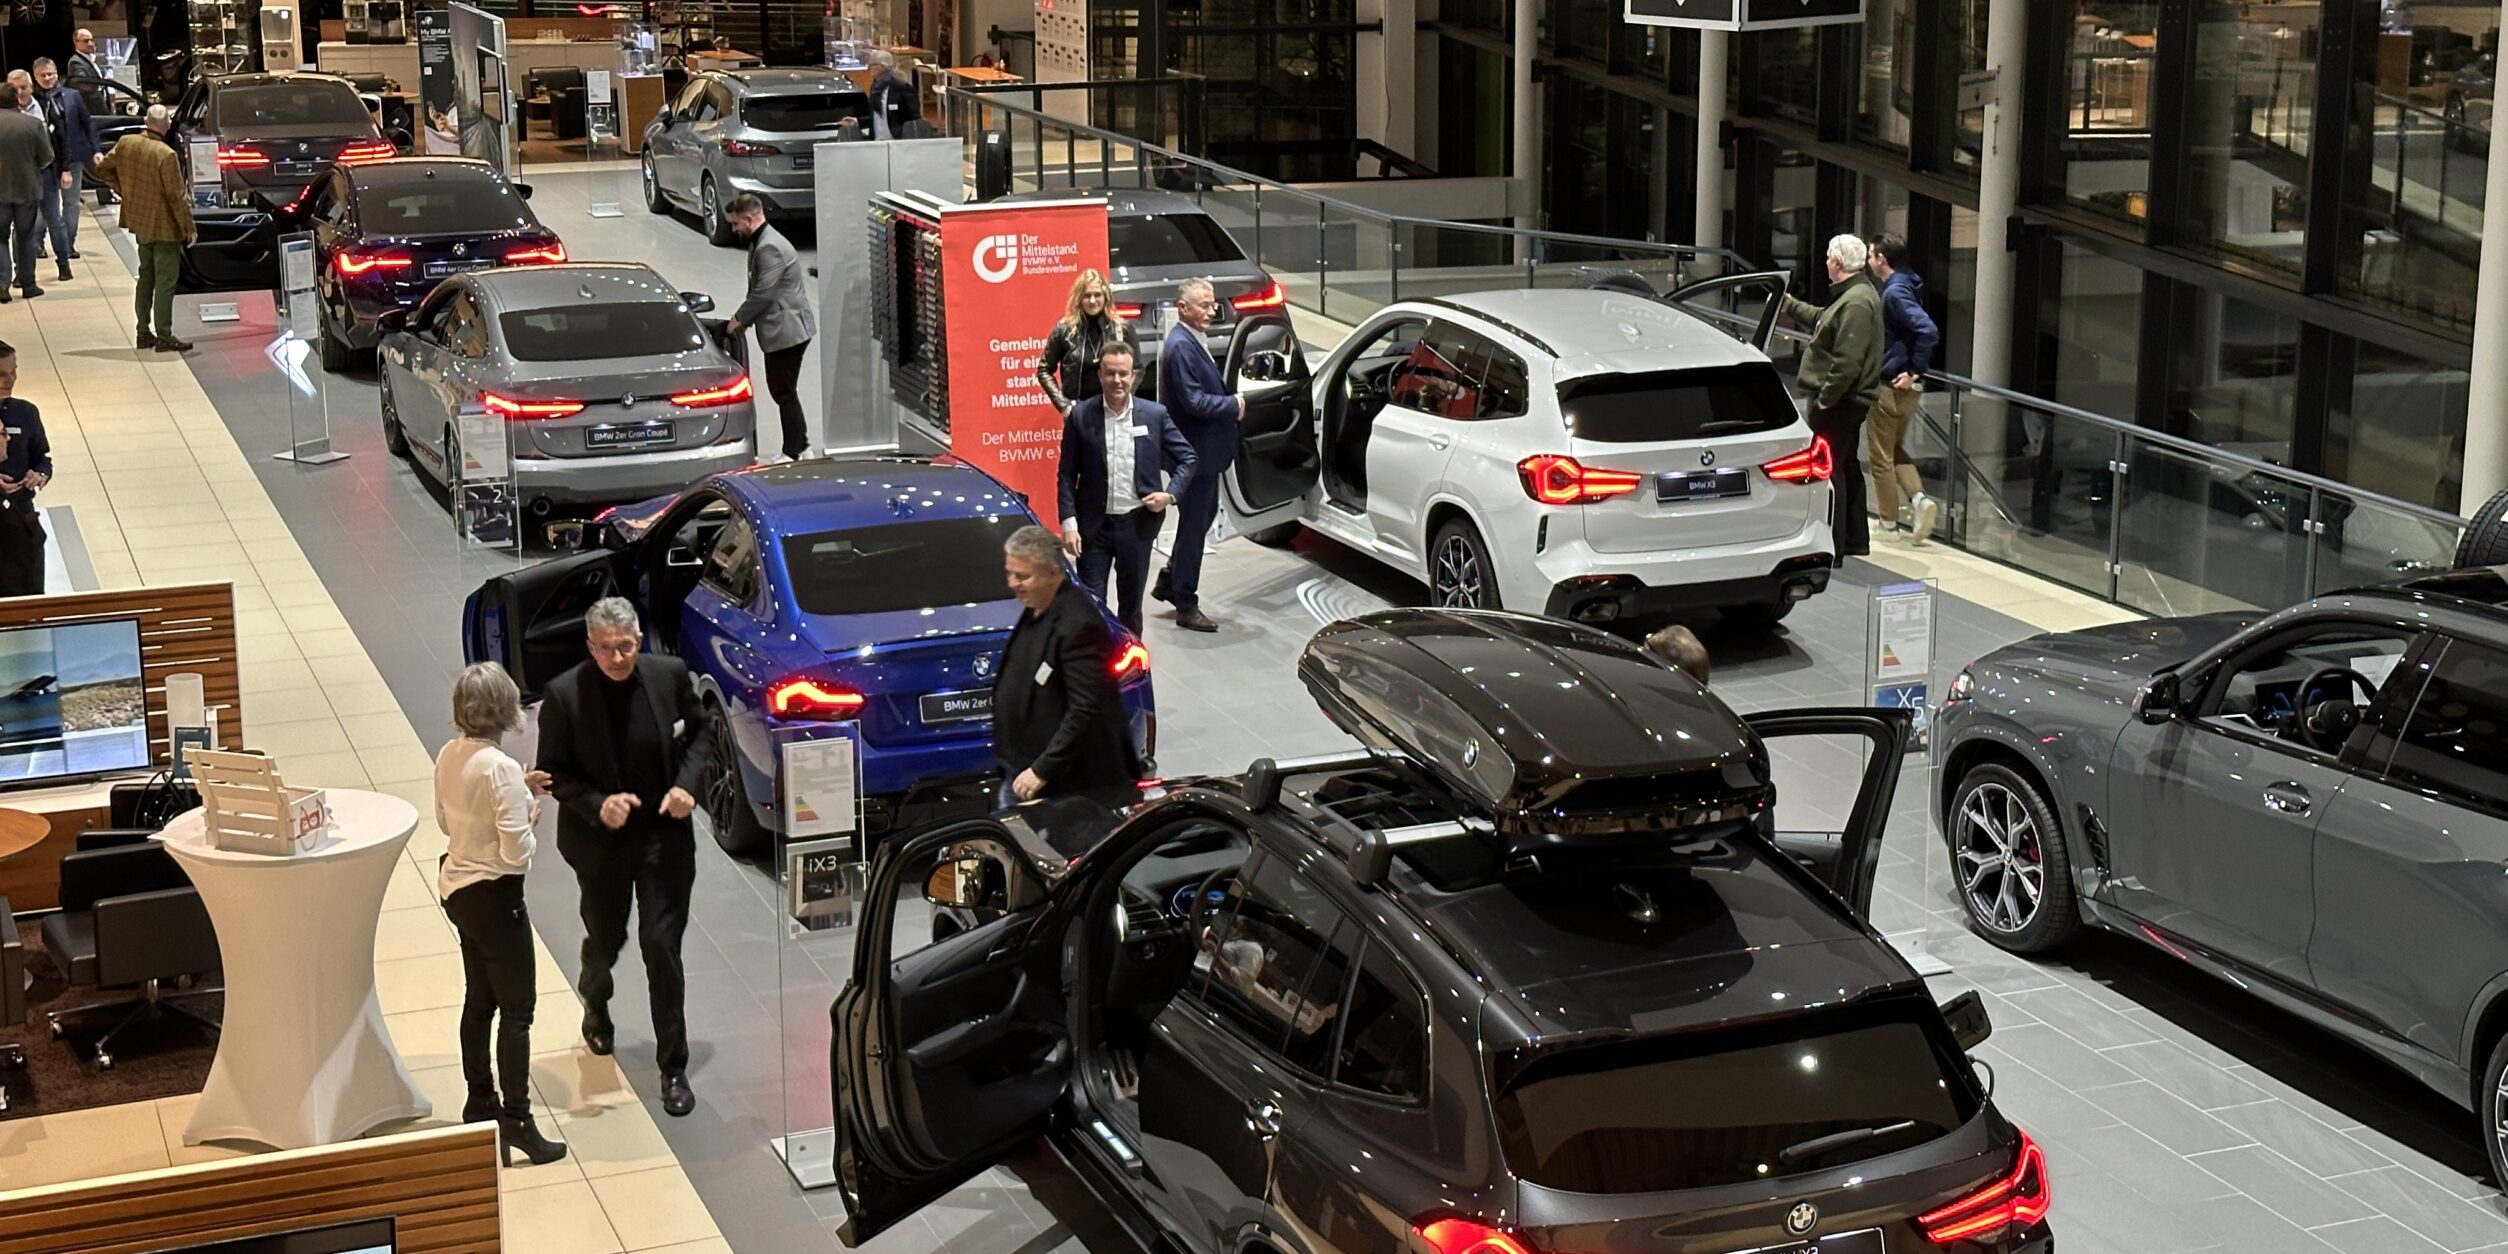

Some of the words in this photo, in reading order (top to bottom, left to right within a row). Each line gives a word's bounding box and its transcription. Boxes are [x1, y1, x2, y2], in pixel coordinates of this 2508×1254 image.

[597, 108, 602, 116] 2
[207, 190, 216, 203] 4
[1022, 233, 1038, 246] Der
[1022, 242, 1079, 257] Mittelstand.
[1022, 256, 1046, 266] BVMW
[1023, 262, 1078, 275] Bundesverband
[990, 337, 1047, 352] Gemeins
[1000, 356, 1020, 370] für
[1006, 374, 1040, 388] stark
[992, 392, 1052, 408] Mittelsta
[594, 432, 614, 441] BMW
[615, 431, 627, 439] 2er
[628, 430, 645, 438] Gran
[982, 432, 1004, 445] Der
[1008, 428, 1063, 443] Mittelsta
[1000, 448, 1043, 462] BVMW
[1689, 481, 1706, 490] BMW
[1707, 480, 1716, 488] X3
[493, 489, 502, 503] 2
[944, 700, 970, 712] BMW
[972, 698, 986, 708] 2er
[808, 856, 837, 873] iX3
